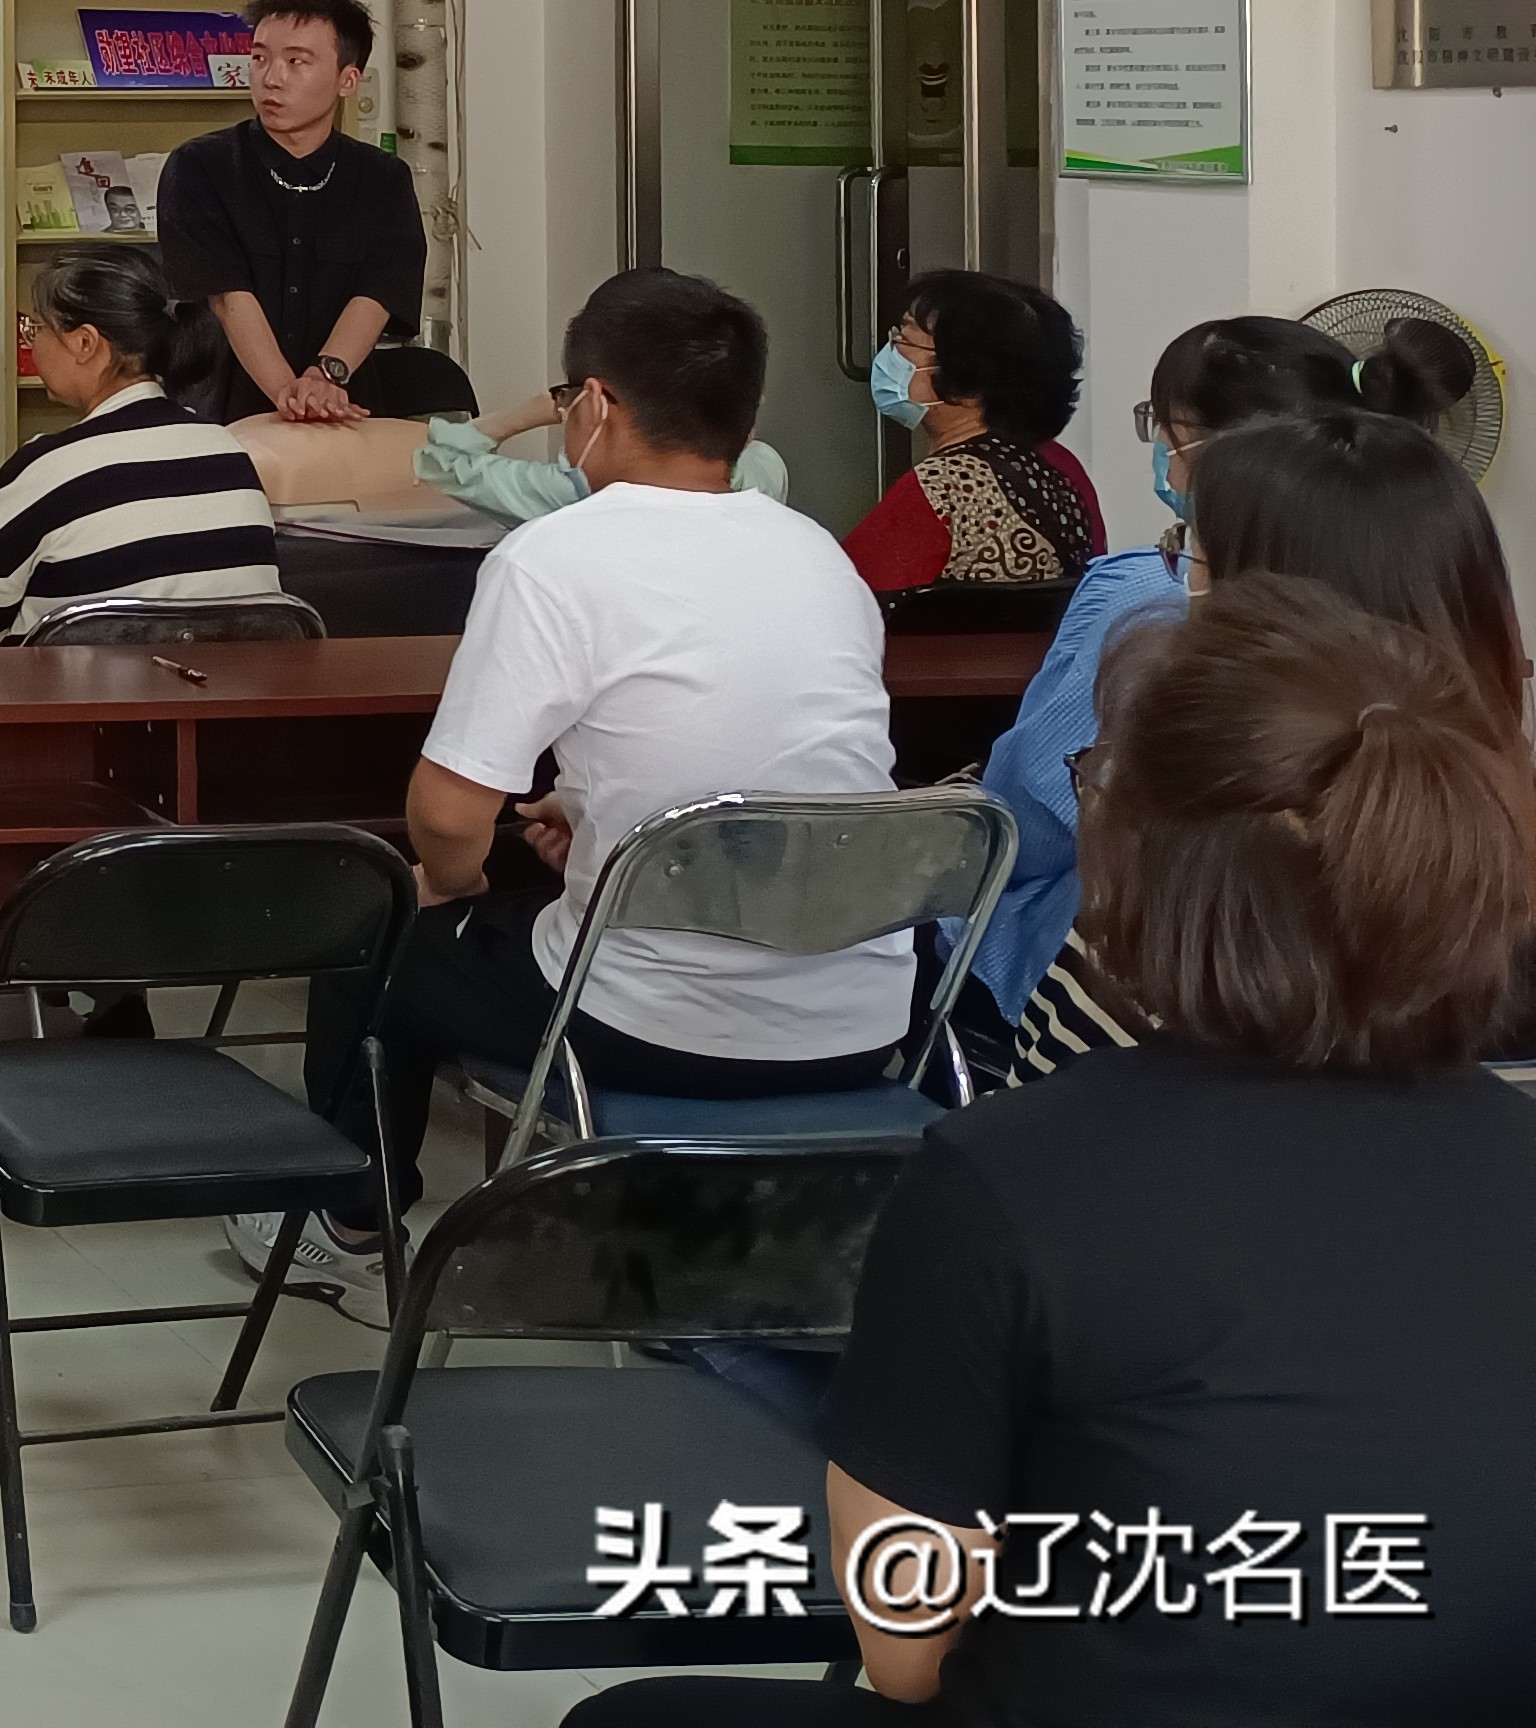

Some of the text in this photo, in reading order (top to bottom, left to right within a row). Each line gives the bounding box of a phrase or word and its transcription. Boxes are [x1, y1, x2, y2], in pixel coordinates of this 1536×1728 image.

[43, 68, 94, 87] 未成年人
[217, 62, 251, 87] 家
